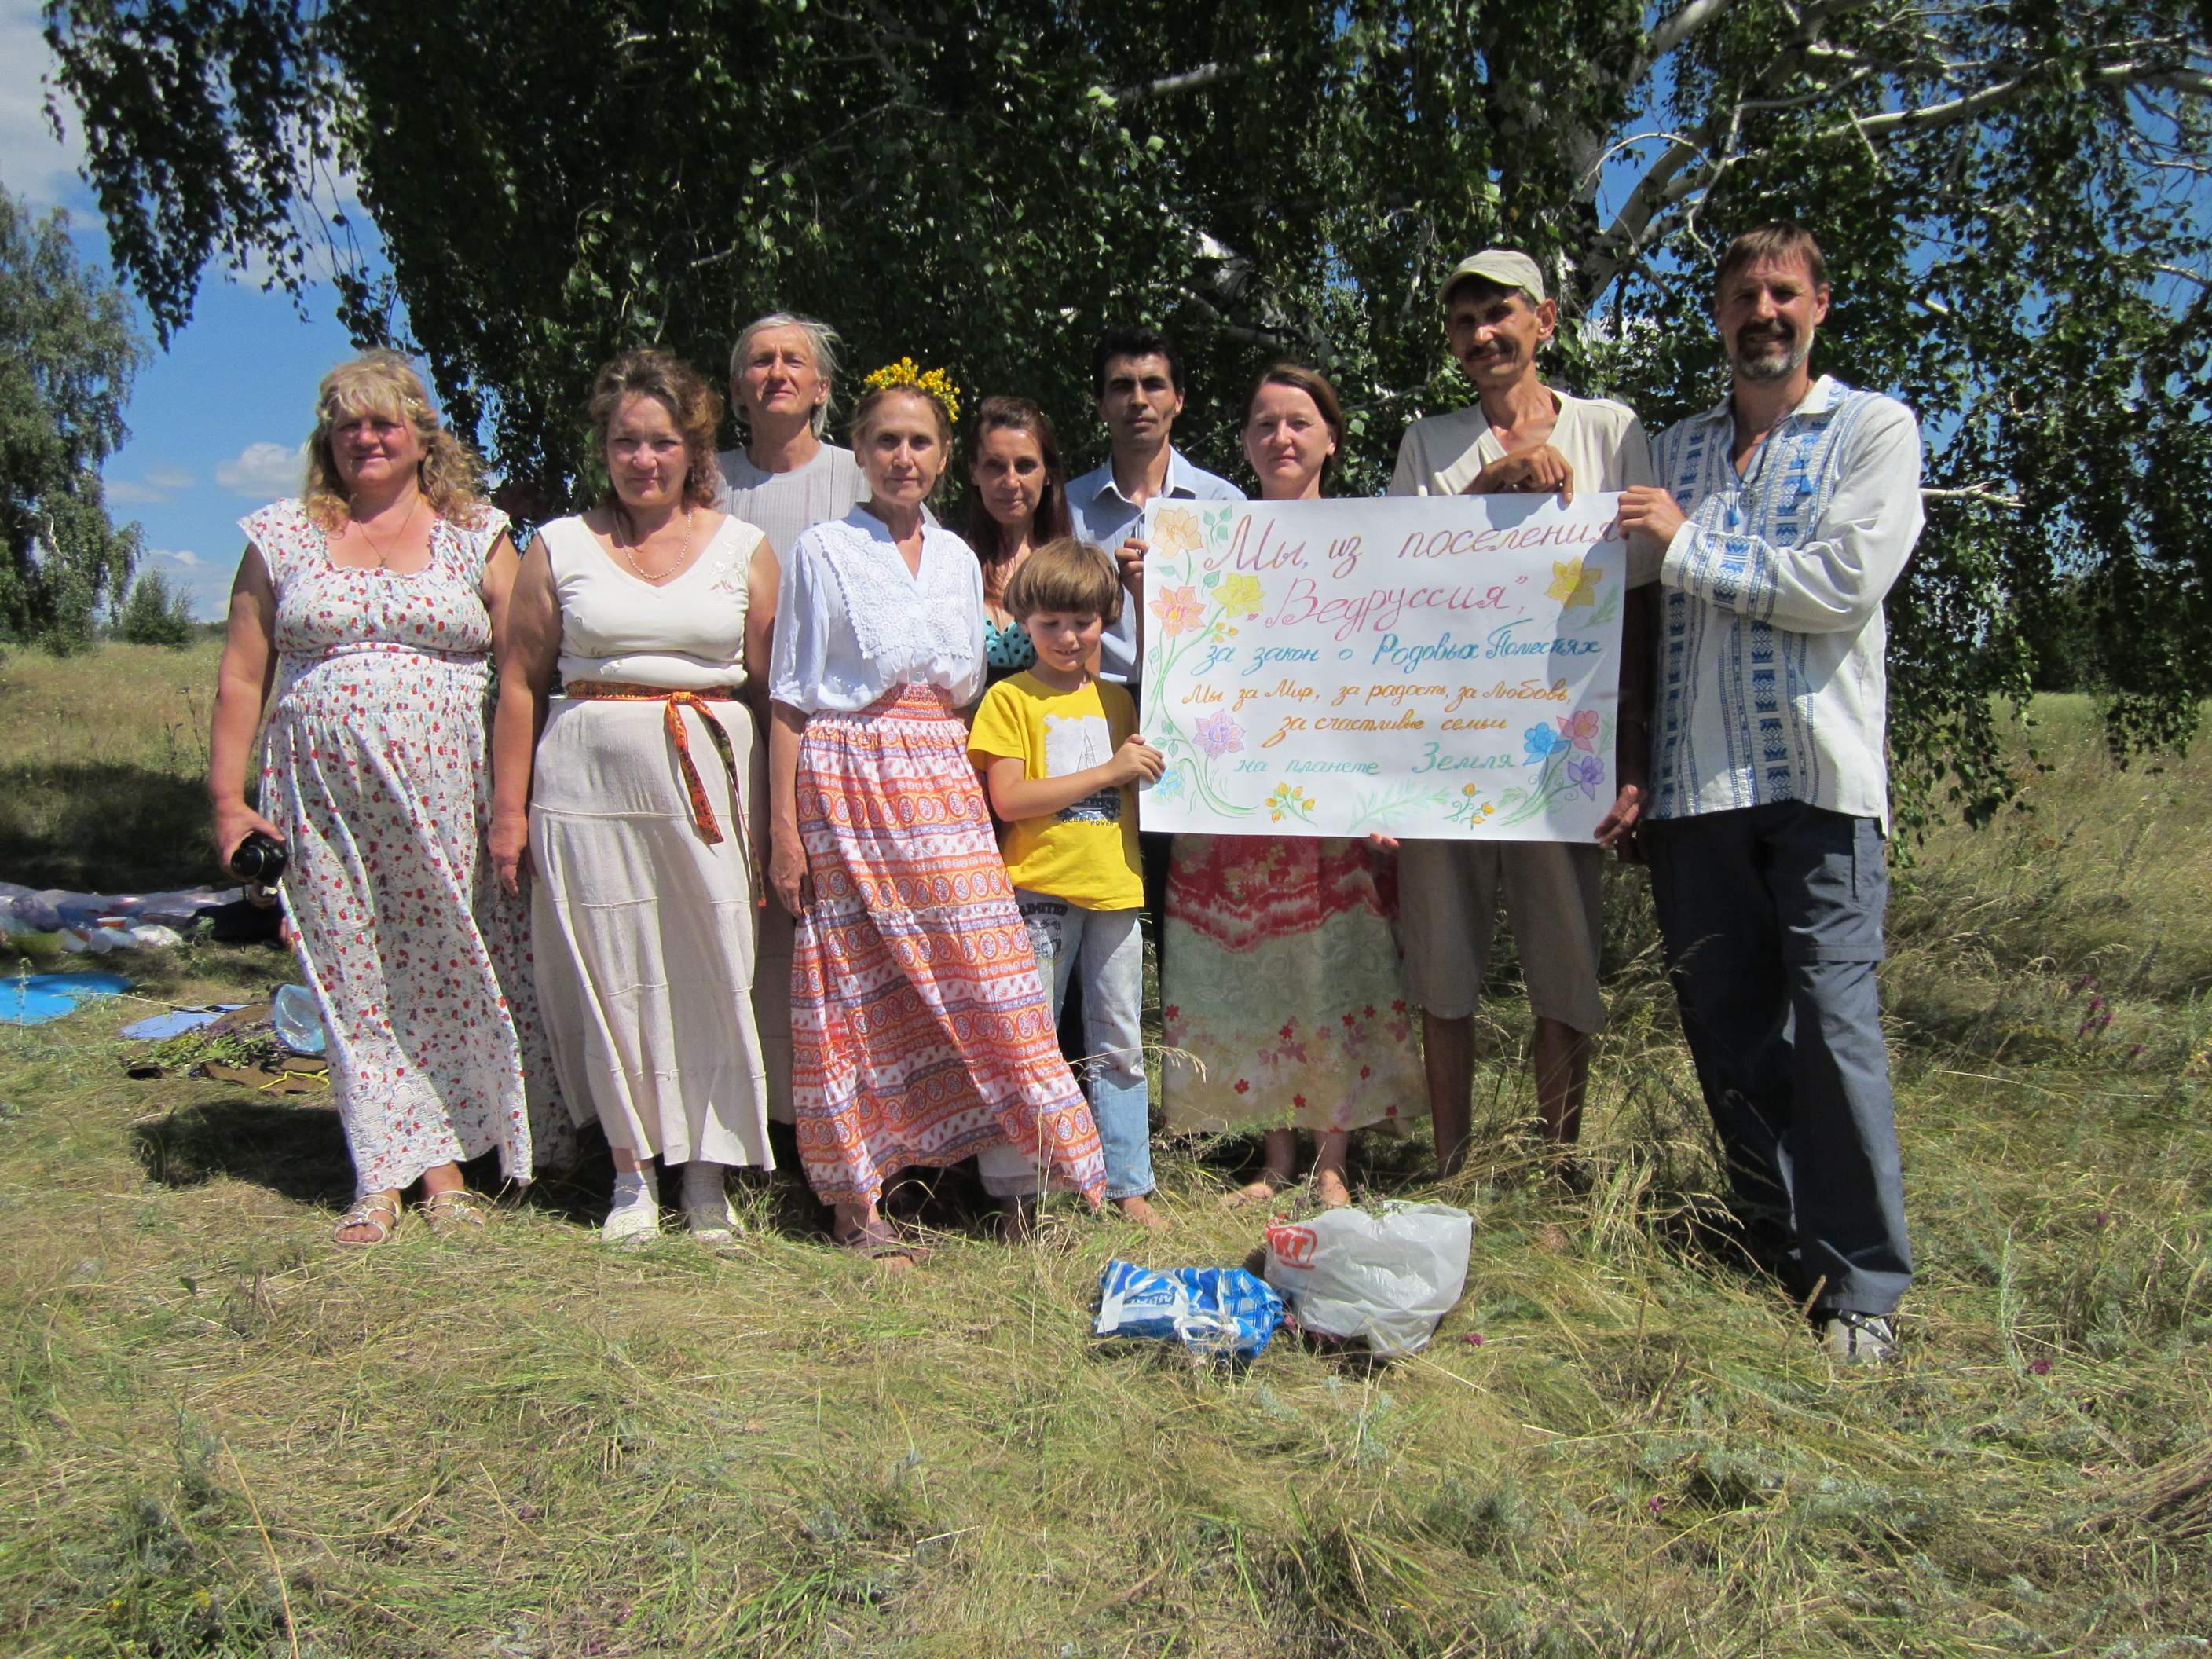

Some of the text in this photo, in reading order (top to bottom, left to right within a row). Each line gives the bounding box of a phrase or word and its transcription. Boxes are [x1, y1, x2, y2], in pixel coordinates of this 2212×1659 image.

[1204, 514, 1618, 579] Мы, из поселения
[1190, 617, 1602, 676] за закон о Родовых Поместьях
[1181, 677, 1572, 713] Мы за Мир, за радость, за Любовь,
[1261, 708, 1508, 749] за счастливые семьи
[1232, 741, 1516, 776] на планете Земля
